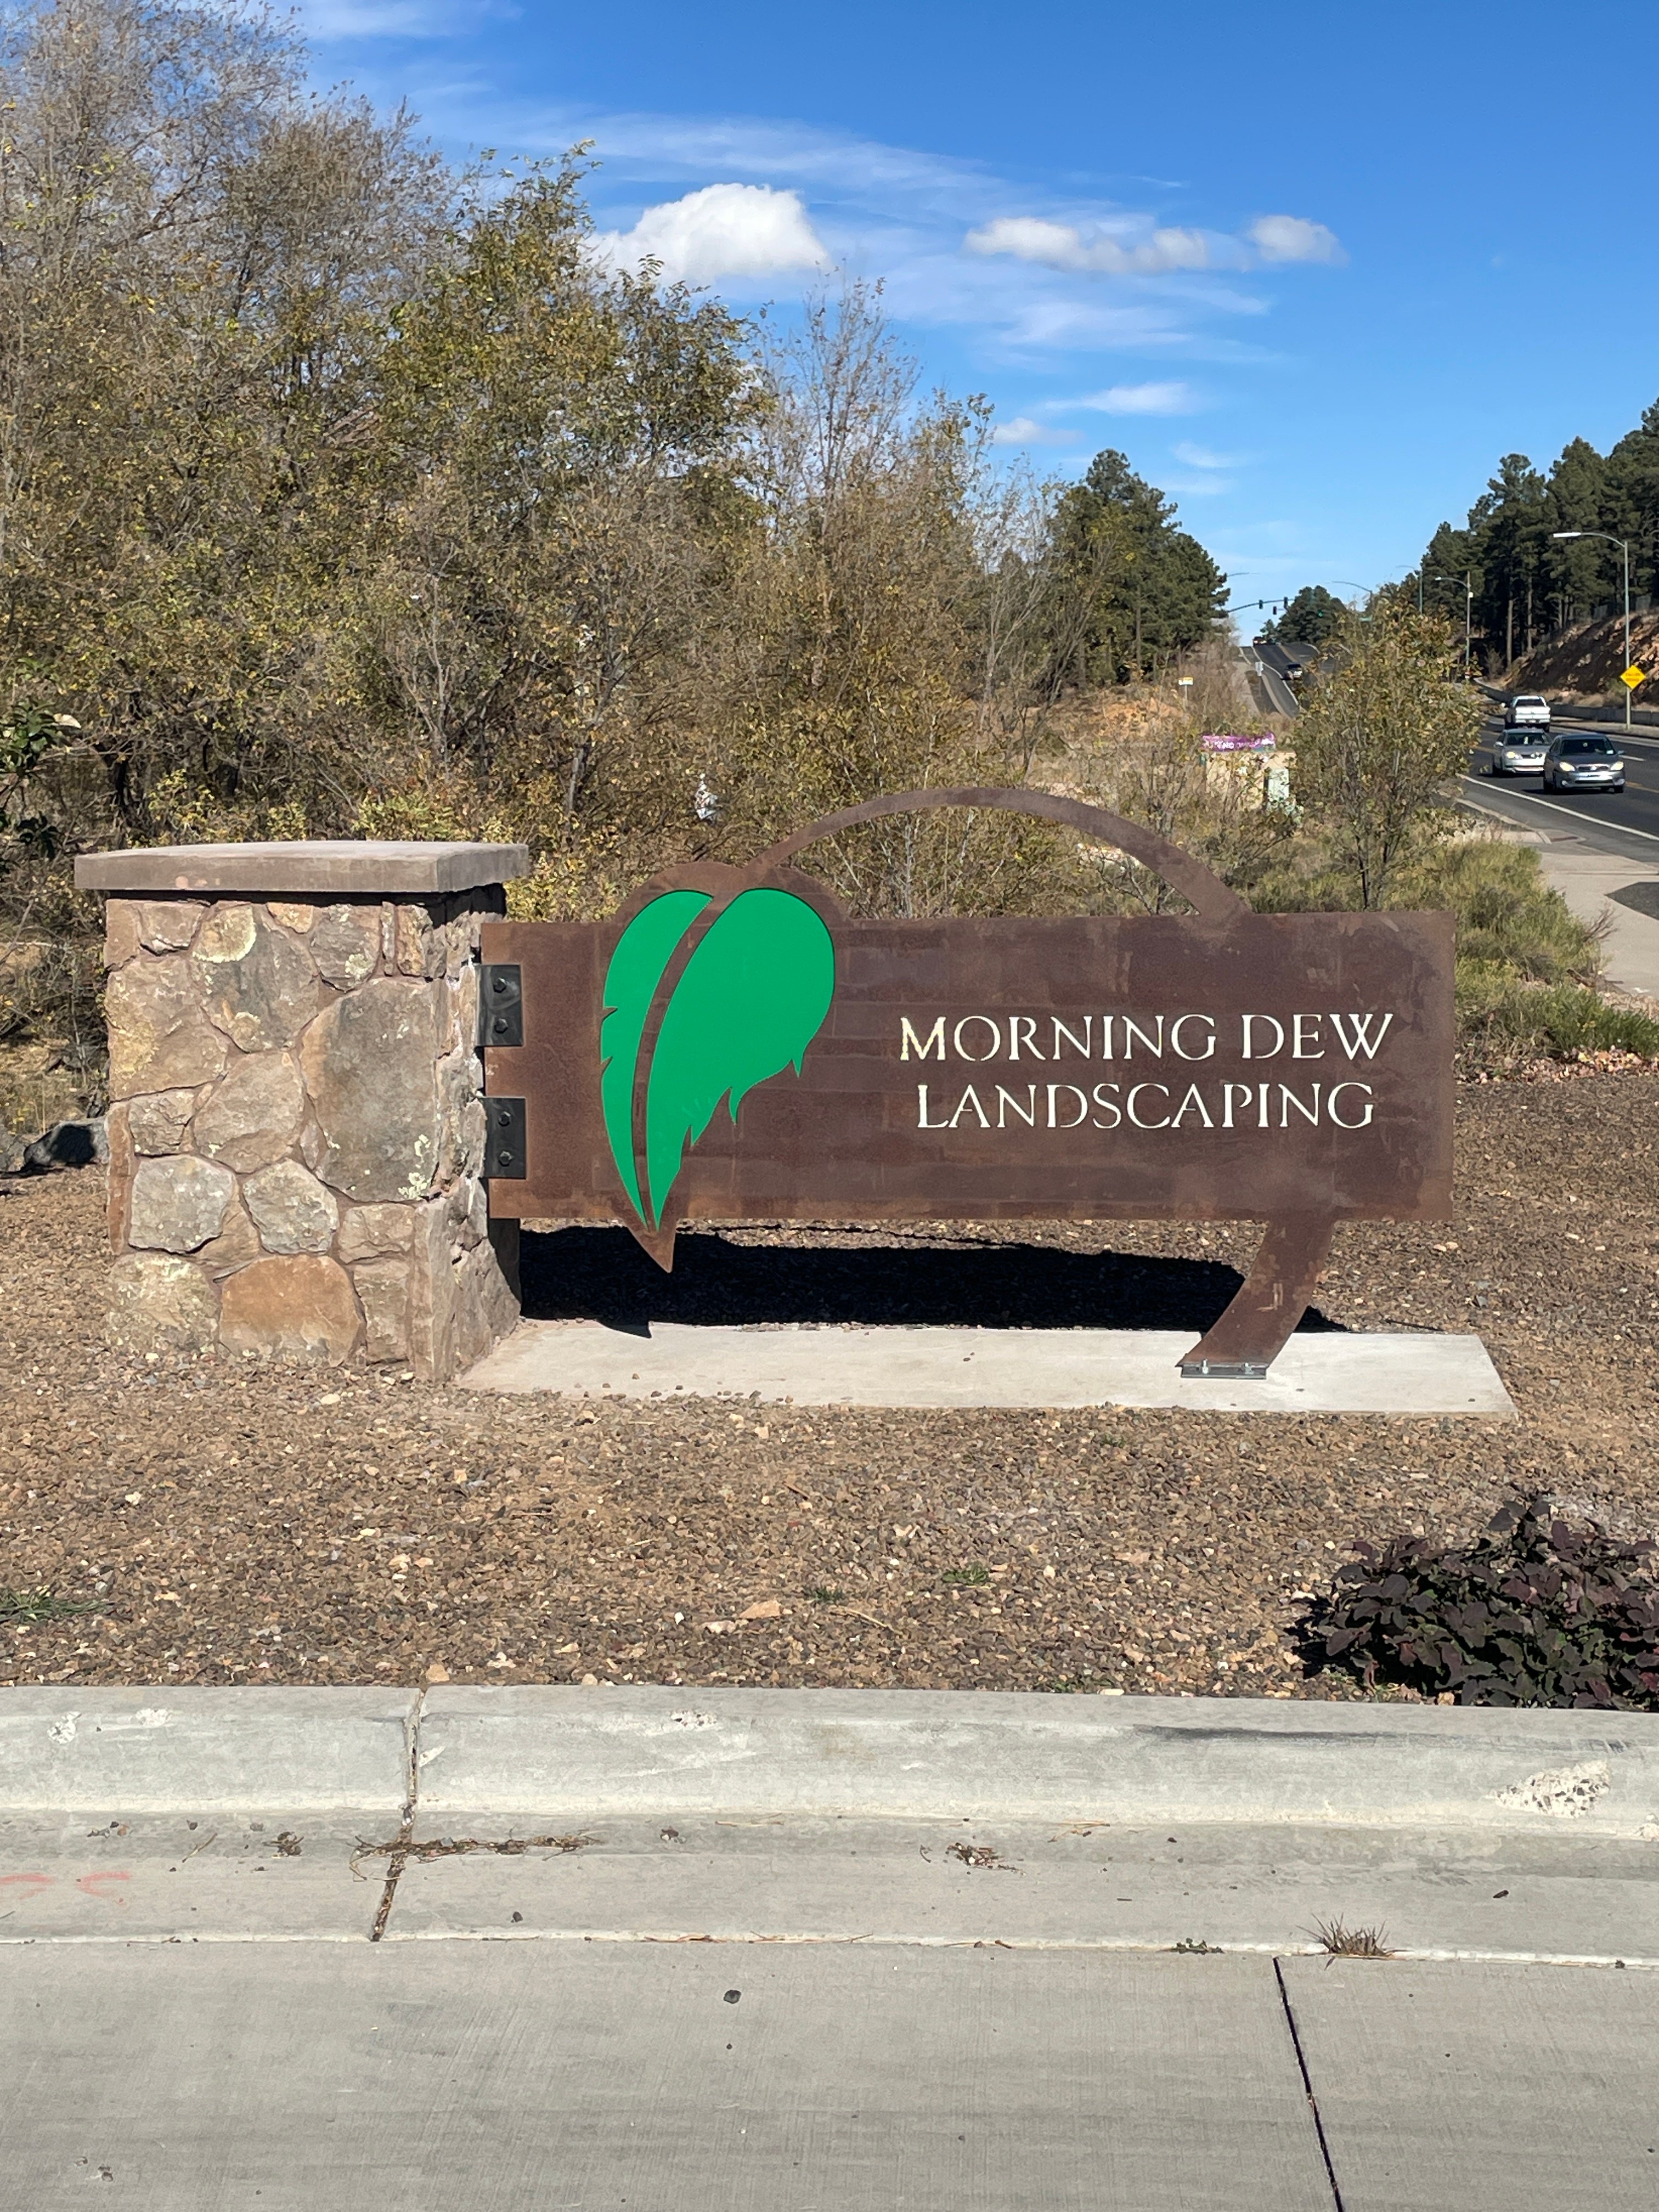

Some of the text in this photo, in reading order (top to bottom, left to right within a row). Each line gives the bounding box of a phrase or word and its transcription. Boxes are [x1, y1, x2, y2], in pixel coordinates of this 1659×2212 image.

[900, 1013, 1393, 1061] MORNING DEW
[917, 1082, 1373, 1129] LANDSCAPING
